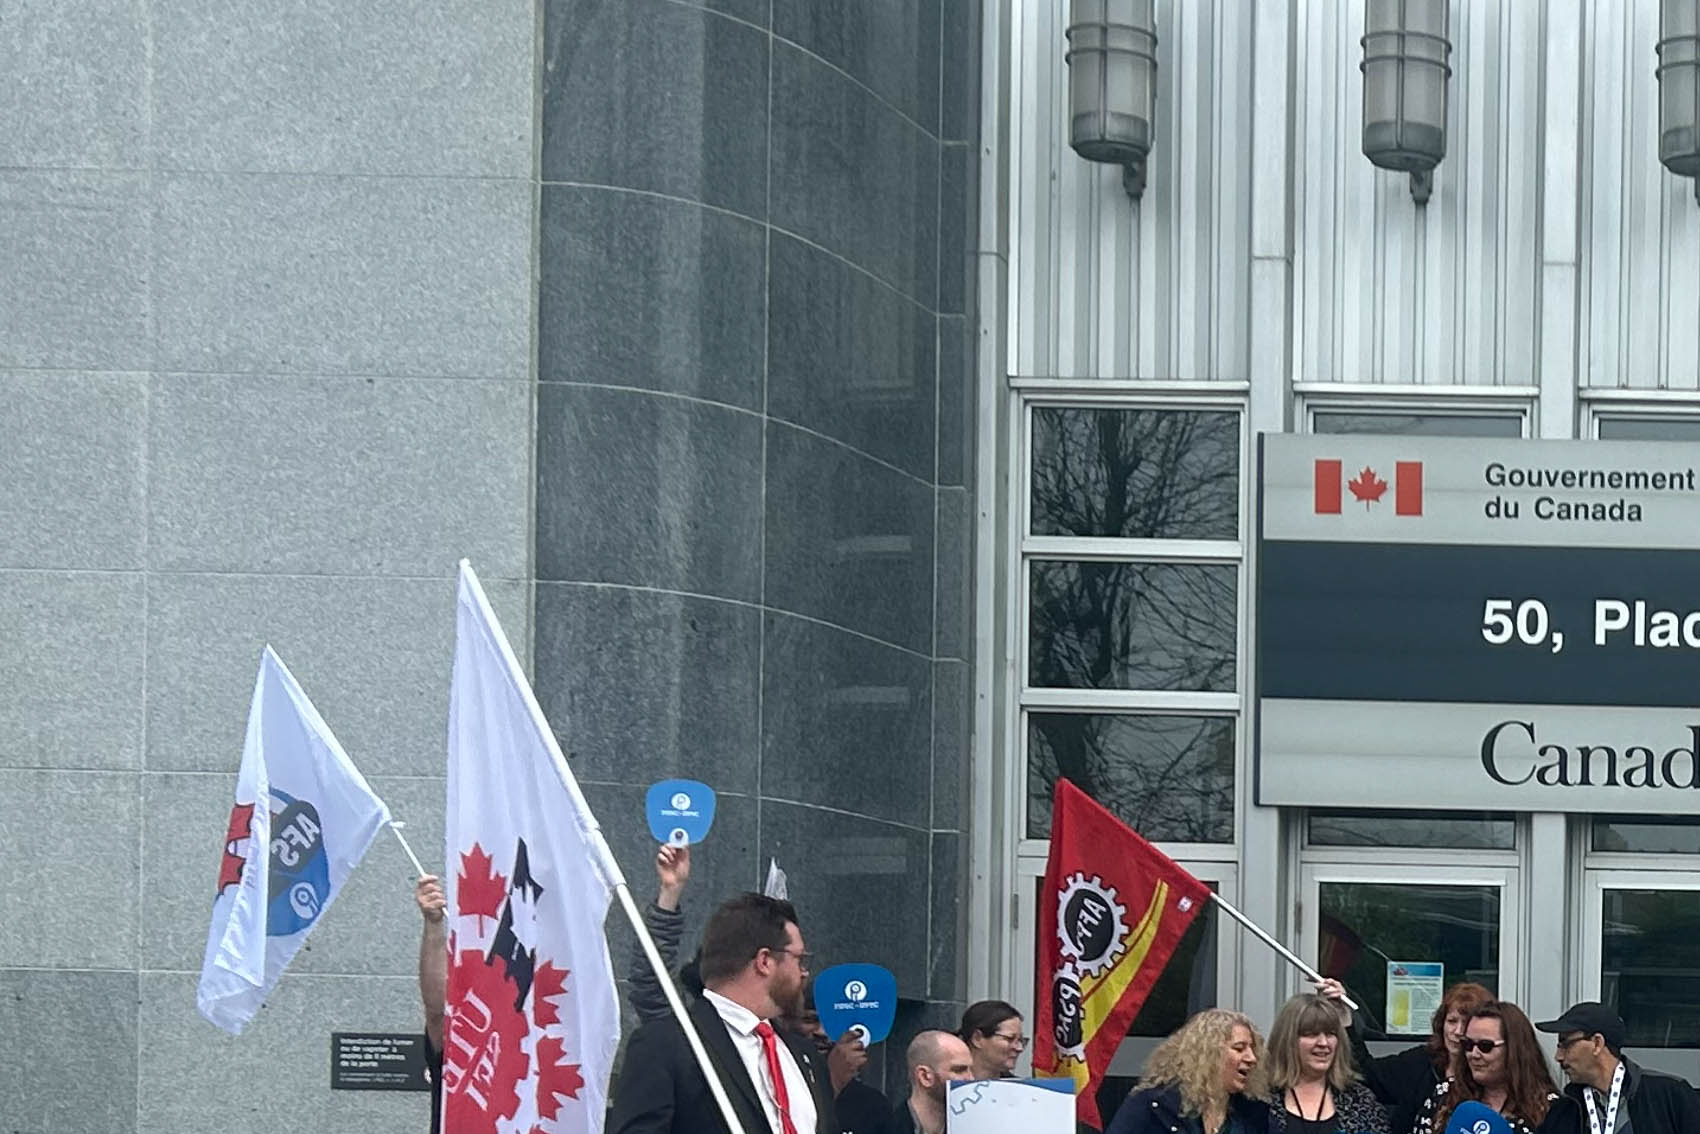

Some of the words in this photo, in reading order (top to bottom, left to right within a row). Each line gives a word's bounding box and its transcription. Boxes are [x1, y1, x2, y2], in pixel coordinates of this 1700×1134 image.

[1485, 464, 1695, 490] Gouvernement
[1485, 498, 1519, 520] du
[1535, 498, 1643, 523] Canada
[1481, 600, 1565, 653] 50,
